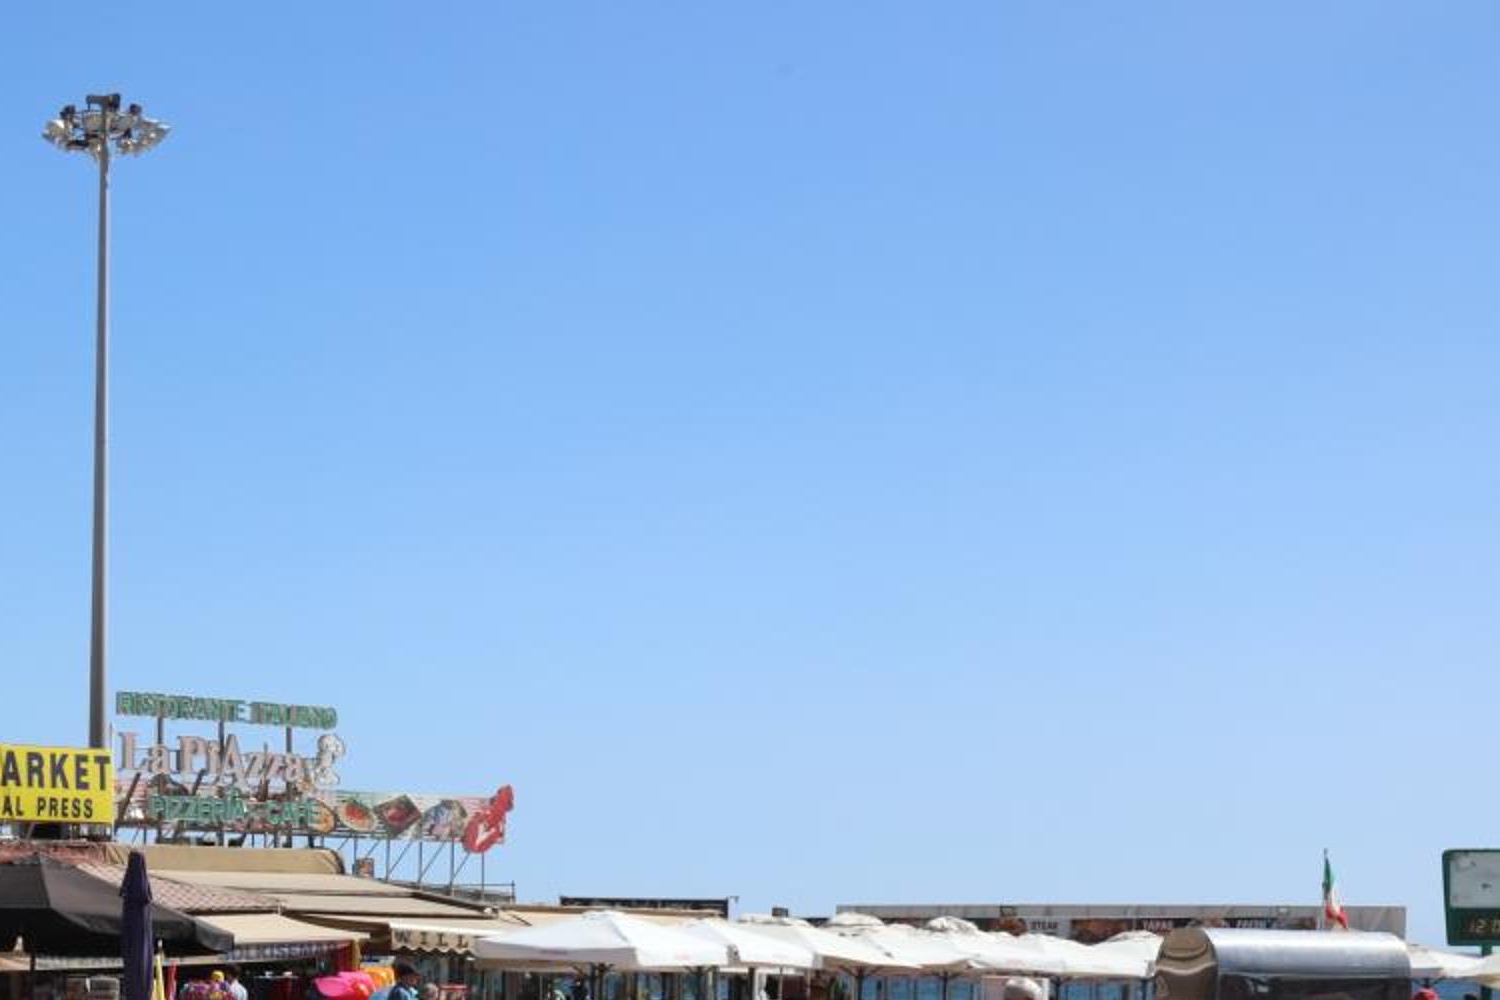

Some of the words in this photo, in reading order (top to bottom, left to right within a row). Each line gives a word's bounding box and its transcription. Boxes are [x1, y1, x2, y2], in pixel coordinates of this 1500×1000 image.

[116, 691, 245, 722] RISTORANTE
[37, 797, 93, 818] PRESS
[394, 929, 484, 949] WILL
